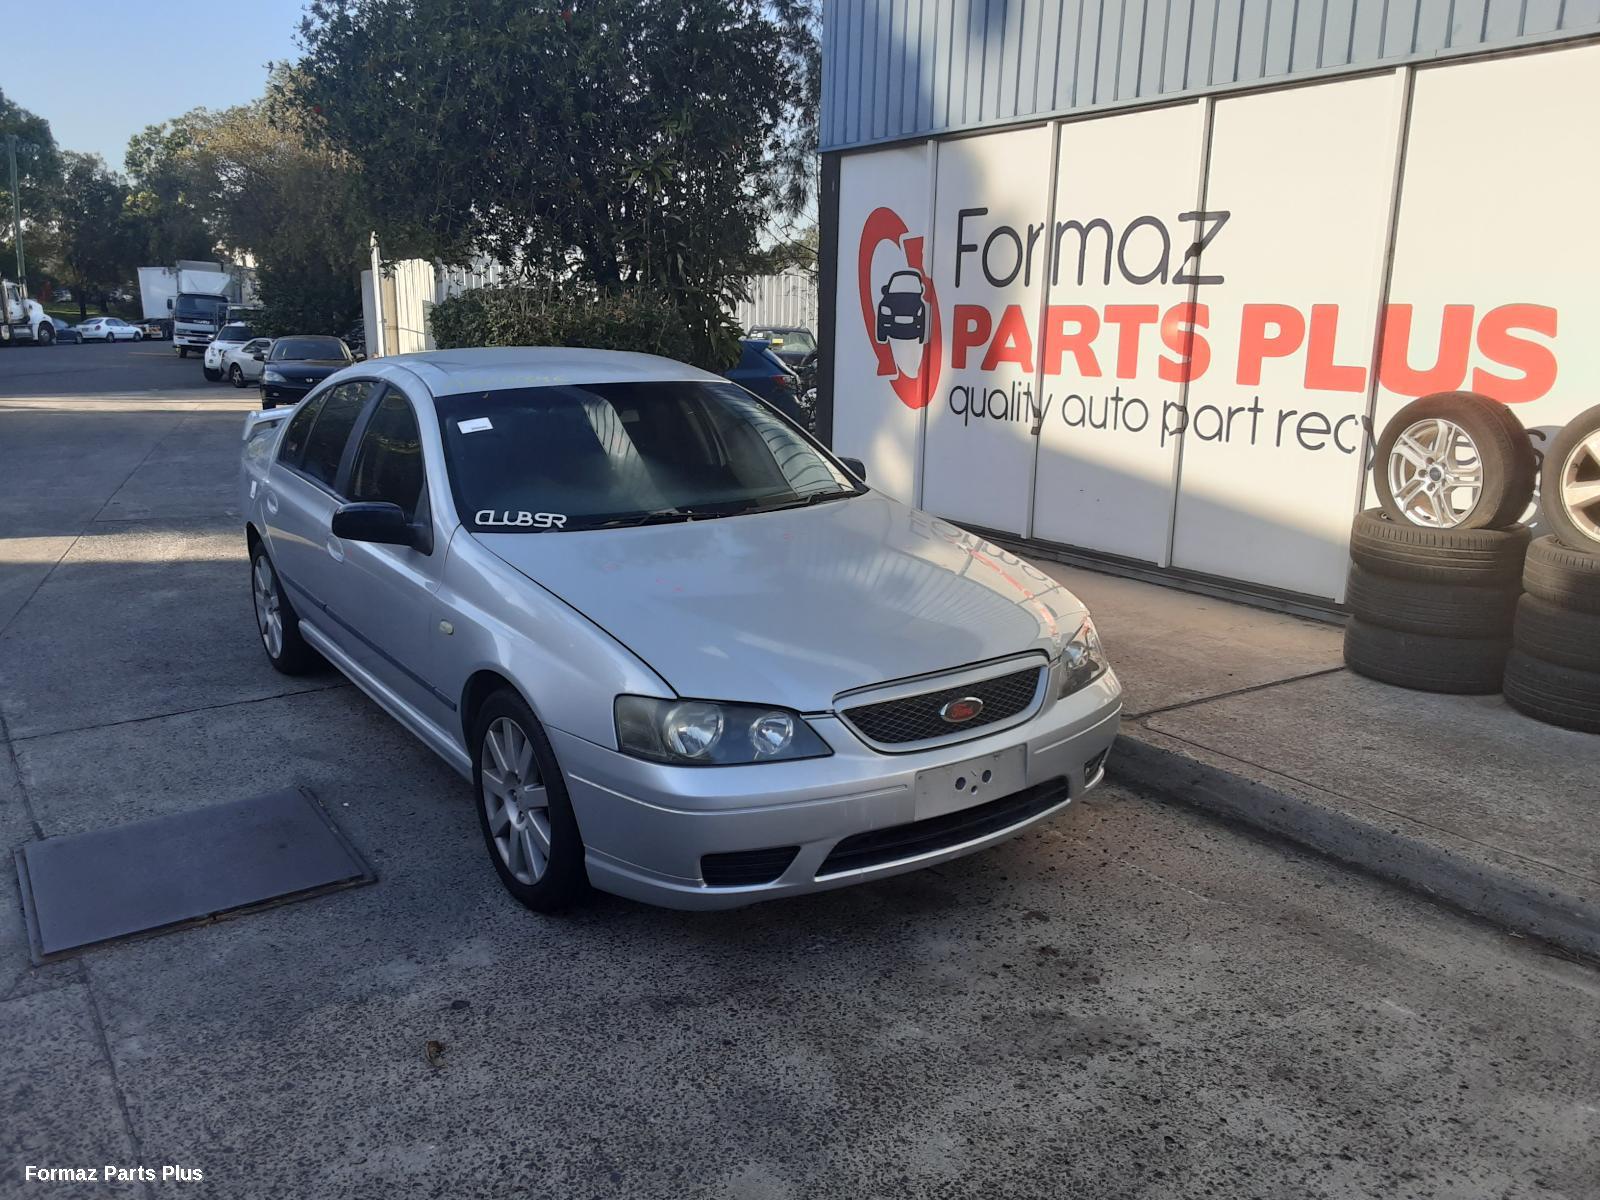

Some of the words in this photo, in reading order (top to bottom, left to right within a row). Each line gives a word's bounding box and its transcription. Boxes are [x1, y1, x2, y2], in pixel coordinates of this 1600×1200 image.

[955, 207, 1231, 288] Formaz
[951, 301, 1211, 383] PARTS
[1235, 303, 1558, 403] PLUS
[949, 381, 1053, 436] quality
[1062, 386, 1149, 432] auto
[1161, 395, 1264, 448] part
